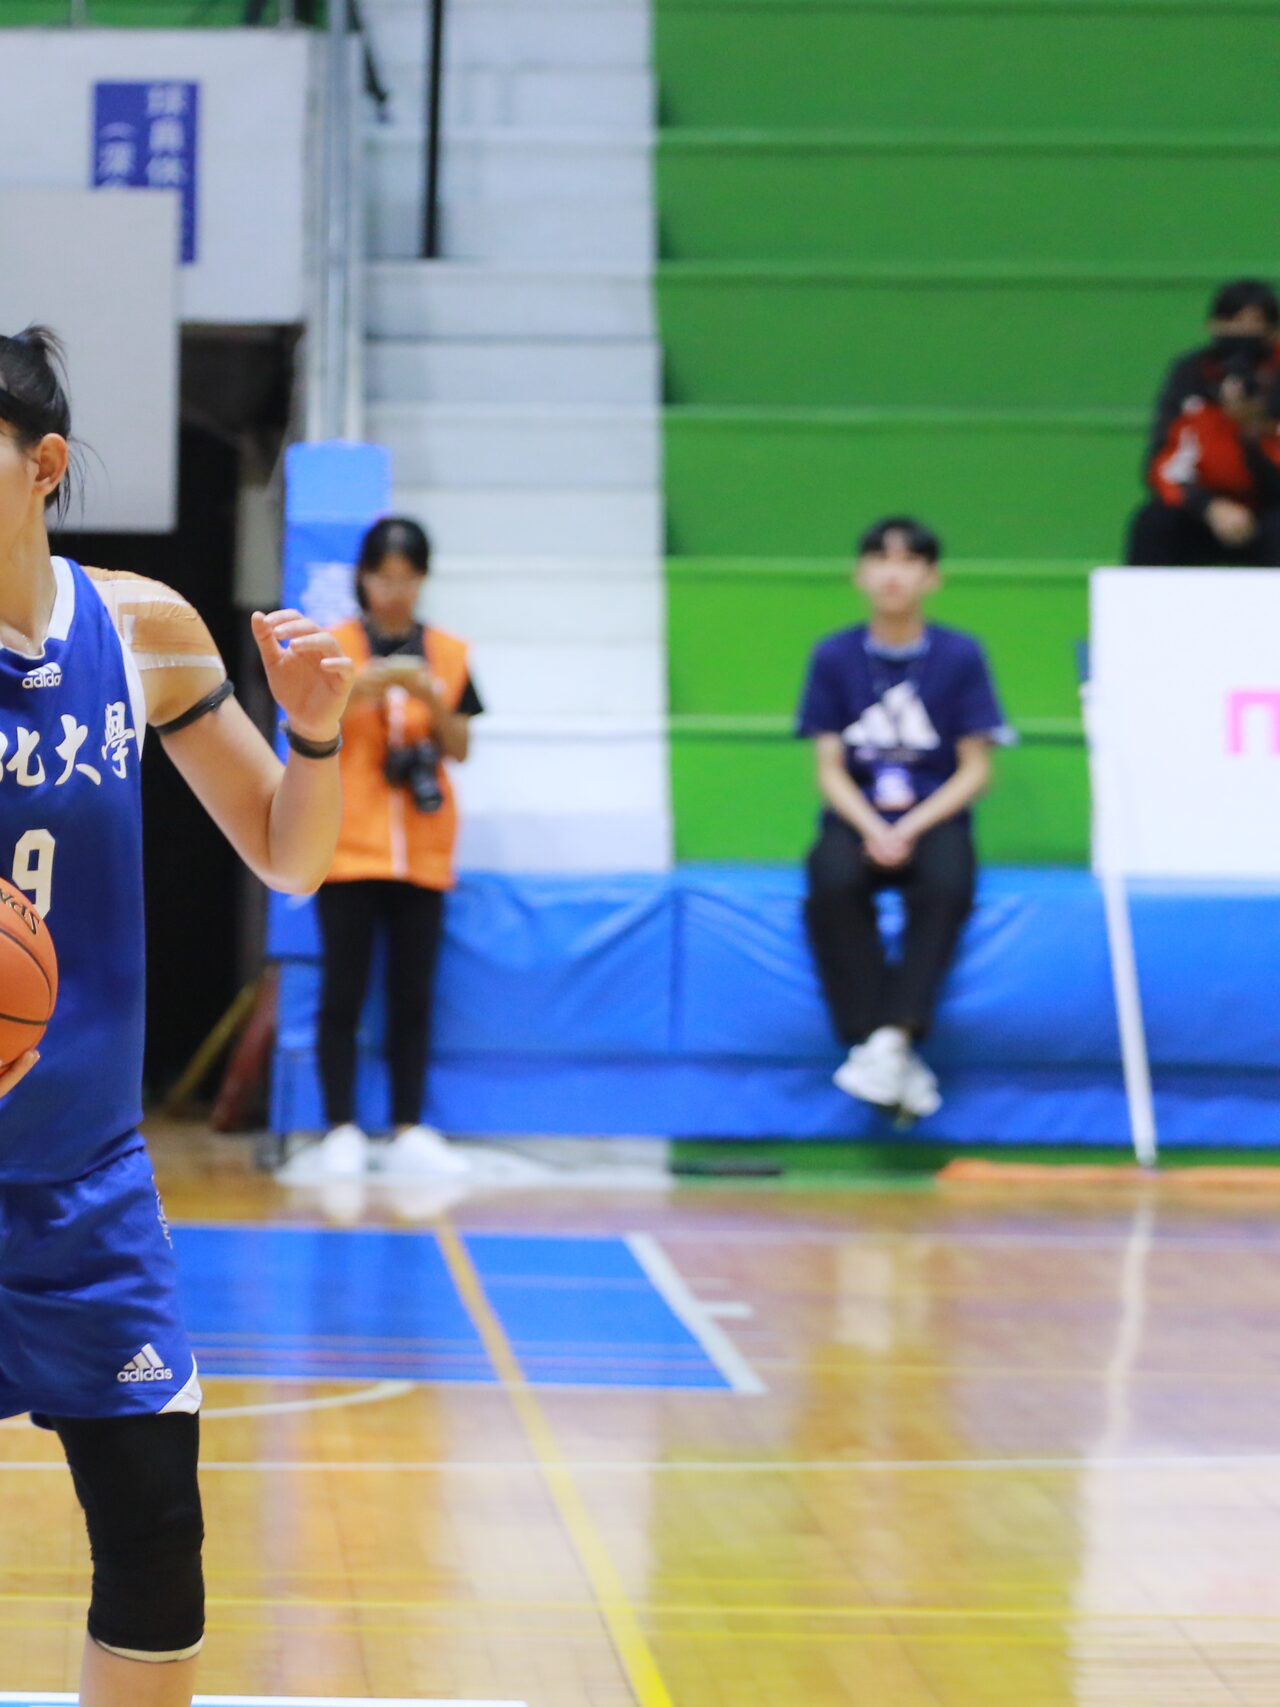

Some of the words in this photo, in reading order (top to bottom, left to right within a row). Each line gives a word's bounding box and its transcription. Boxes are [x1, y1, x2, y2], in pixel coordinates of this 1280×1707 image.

[147, 84, 186, 188] 球員休
[11, 828, 56, 920] 9
[116, 1366, 173, 1383] adidas
